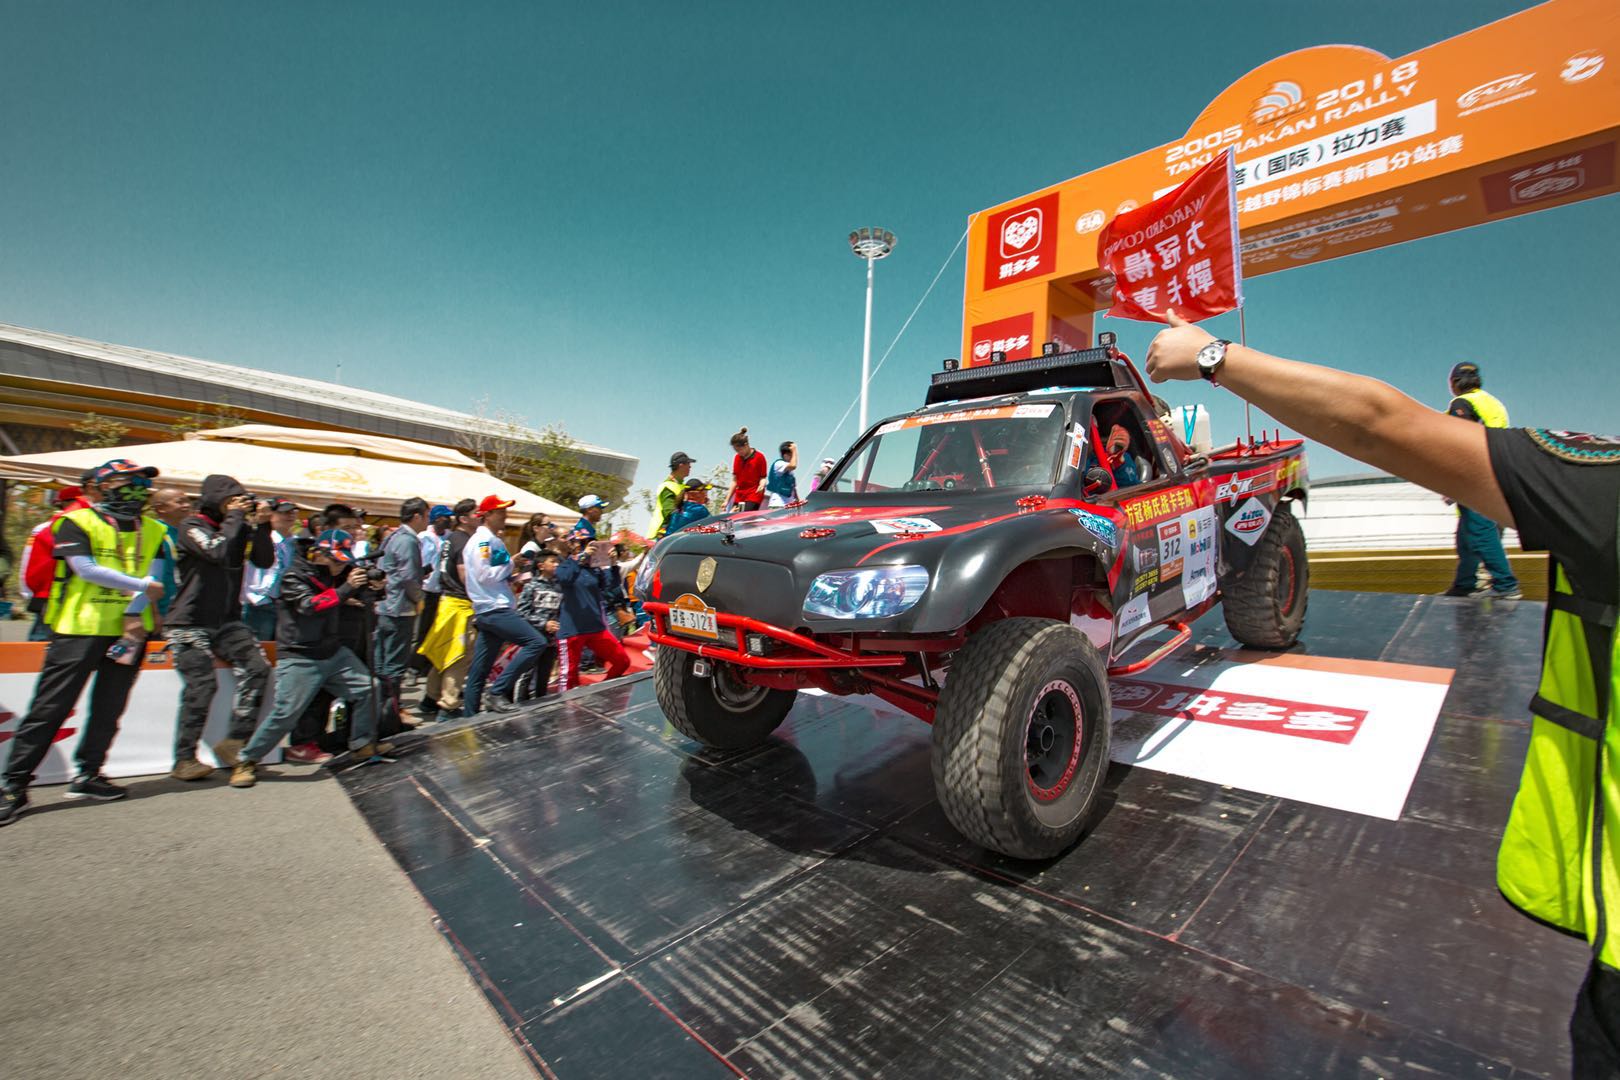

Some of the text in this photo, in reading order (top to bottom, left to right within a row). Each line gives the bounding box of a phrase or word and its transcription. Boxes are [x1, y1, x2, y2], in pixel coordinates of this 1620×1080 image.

[1164, 123, 1244, 163] 2005
[1315, 60, 1419, 111] 2018
[1165, 115, 1317, 177] TAKLMAKAN
[1324, 80, 1418, 124] RALLY
[1237, 134, 1464, 211] 越野锦标赛新疆分站赛
[1163, 538, 1181, 560] 312
[1157, 691, 1356, 731] 拼多多
